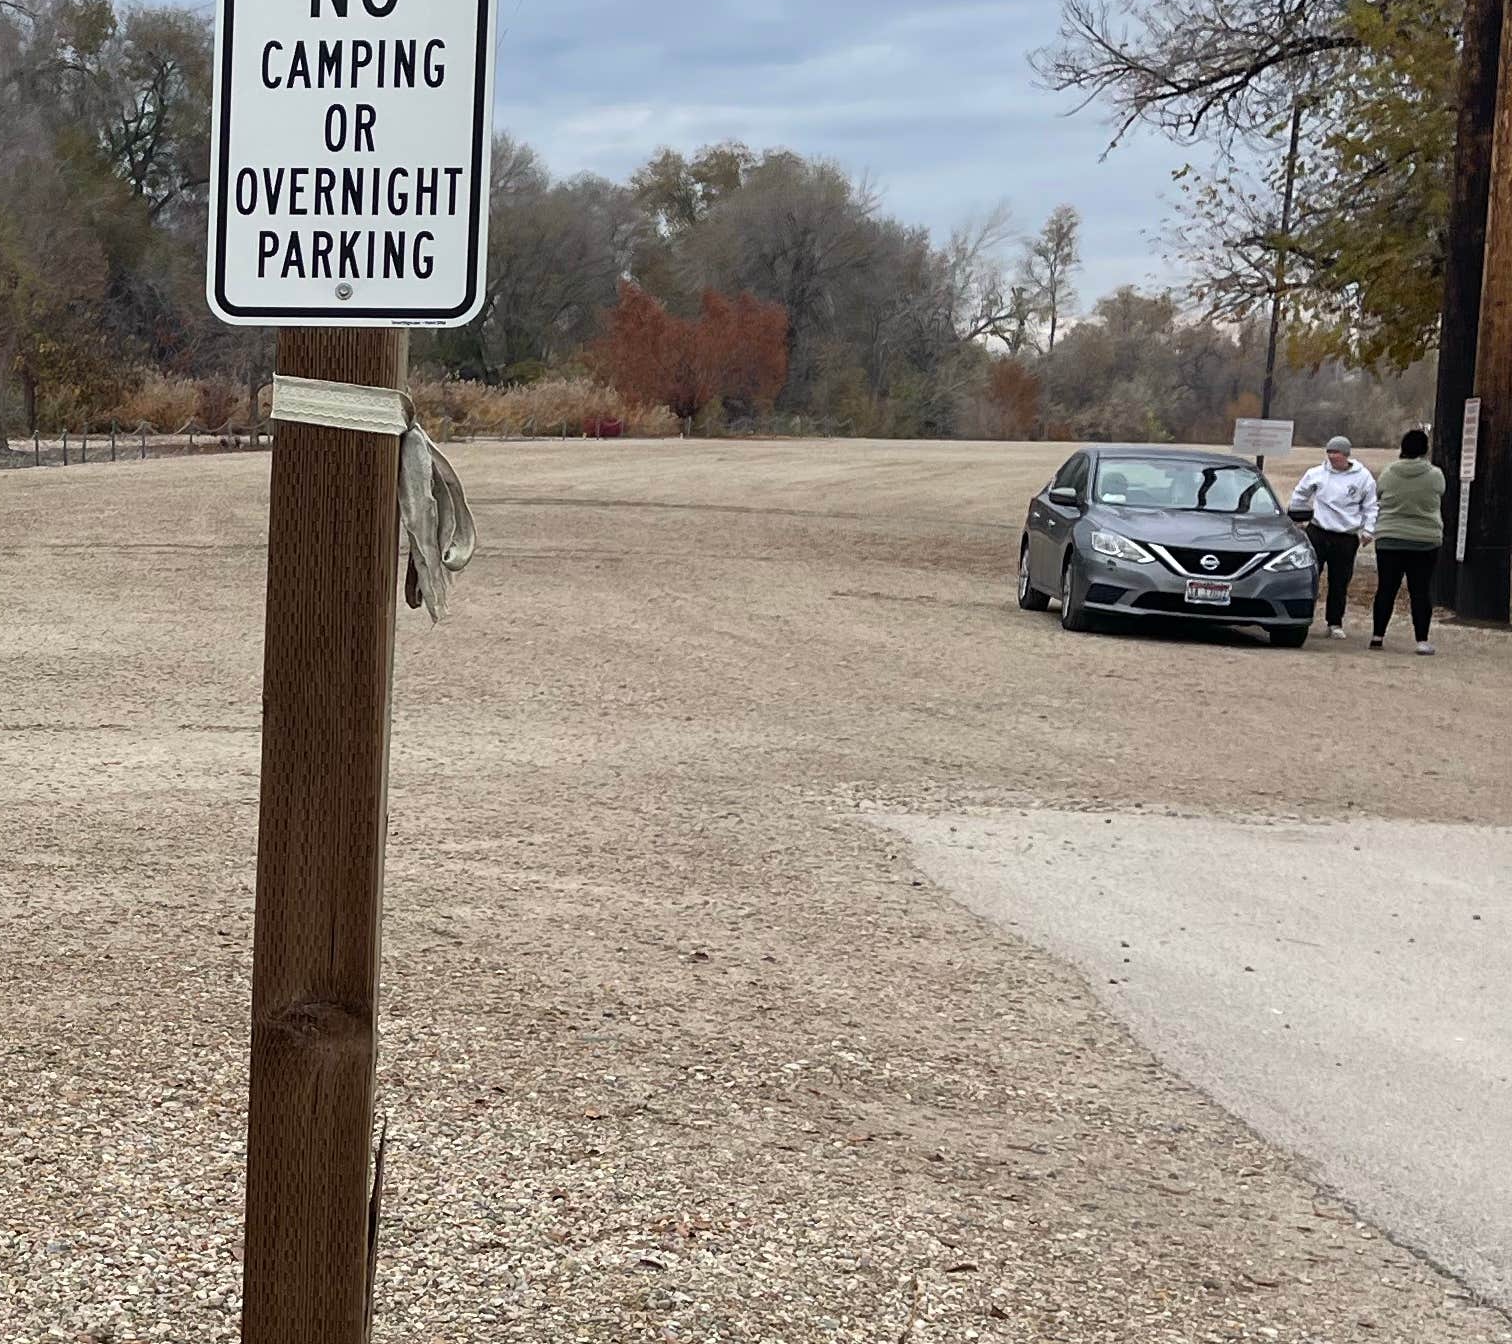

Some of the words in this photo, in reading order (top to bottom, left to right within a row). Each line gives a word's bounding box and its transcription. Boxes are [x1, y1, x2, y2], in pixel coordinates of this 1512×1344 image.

[261, 38, 446, 89] CAMPING
[324, 103, 377, 153] OR
[235, 167, 463, 216] OVERNIGHT
[257, 230, 435, 280] PARKING
